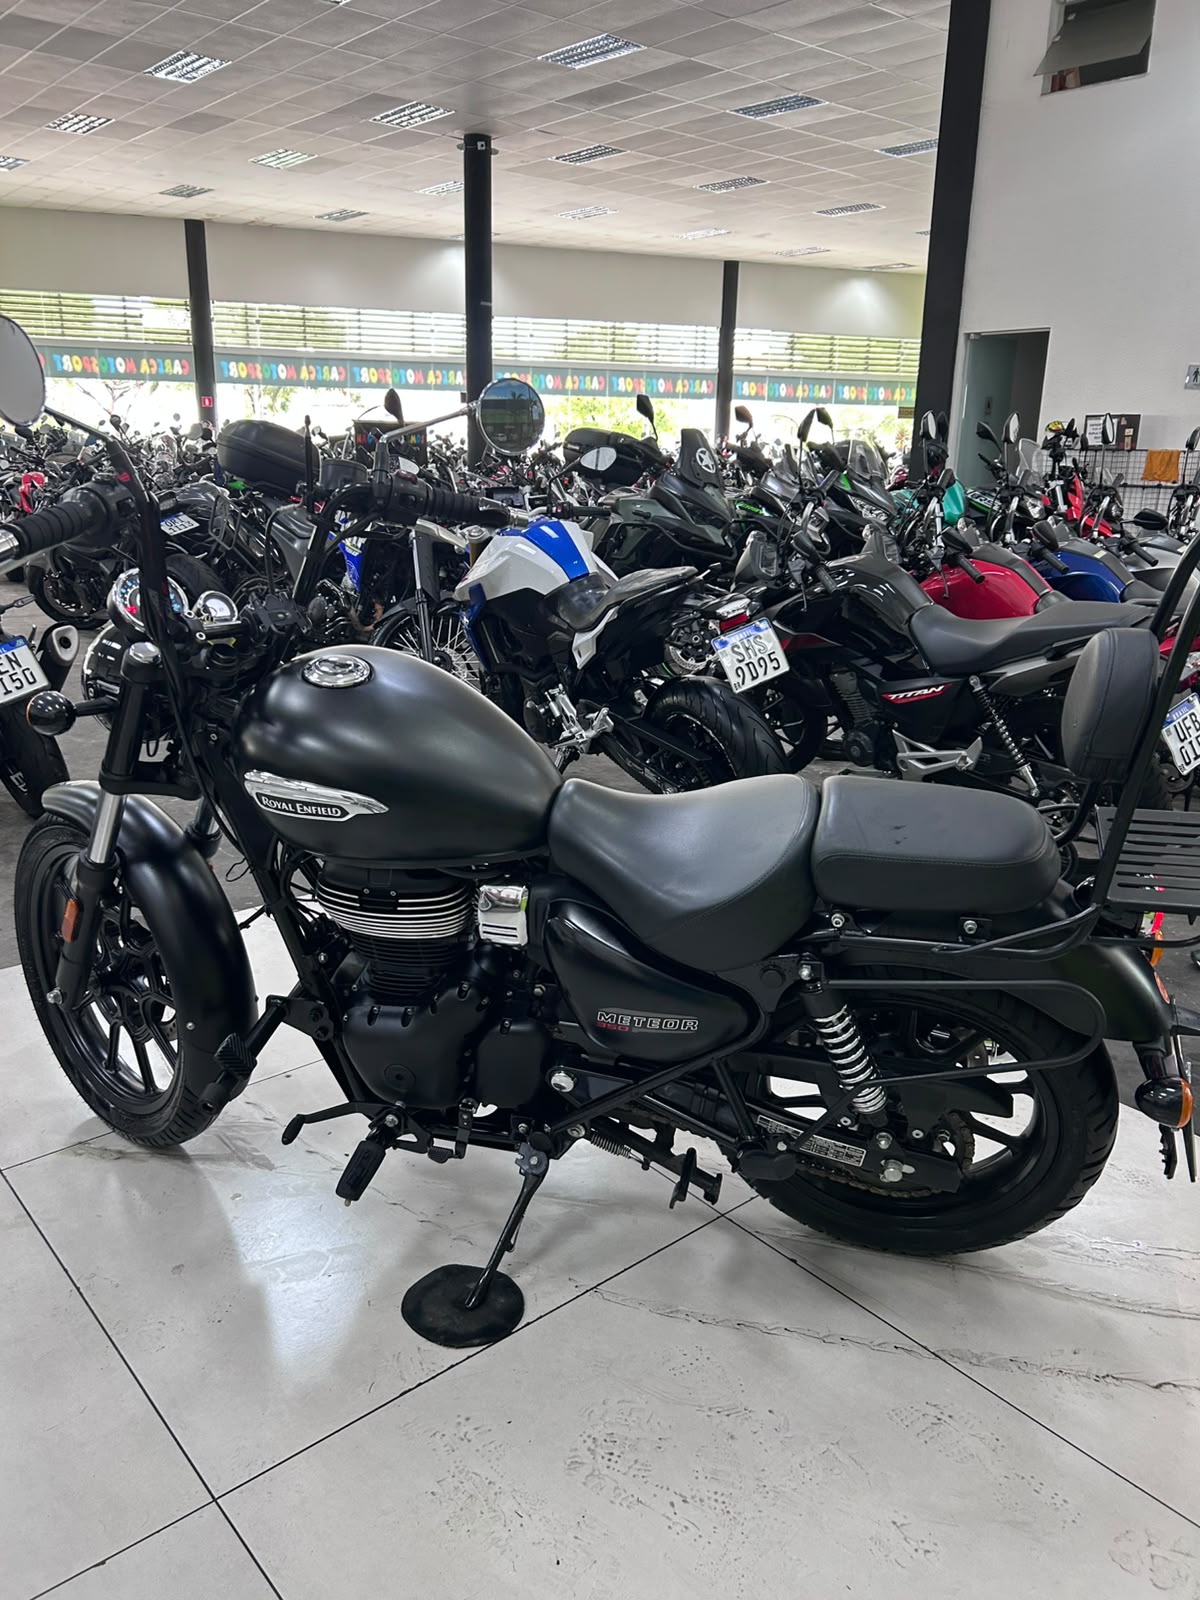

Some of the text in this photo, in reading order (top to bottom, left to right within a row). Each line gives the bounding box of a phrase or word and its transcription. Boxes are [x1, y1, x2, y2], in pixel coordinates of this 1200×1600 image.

[731, 634, 768, 663] SHS
[735, 651, 780, 686] 9D95
[888, 685, 945, 700] TITAN
[1174, 711, 1200, 743] UFB
[261, 795, 341, 817] ROYAL ENFIELD
[596, 1021, 629, 1032] 350
[597, 1011, 698, 1031] METEOR
